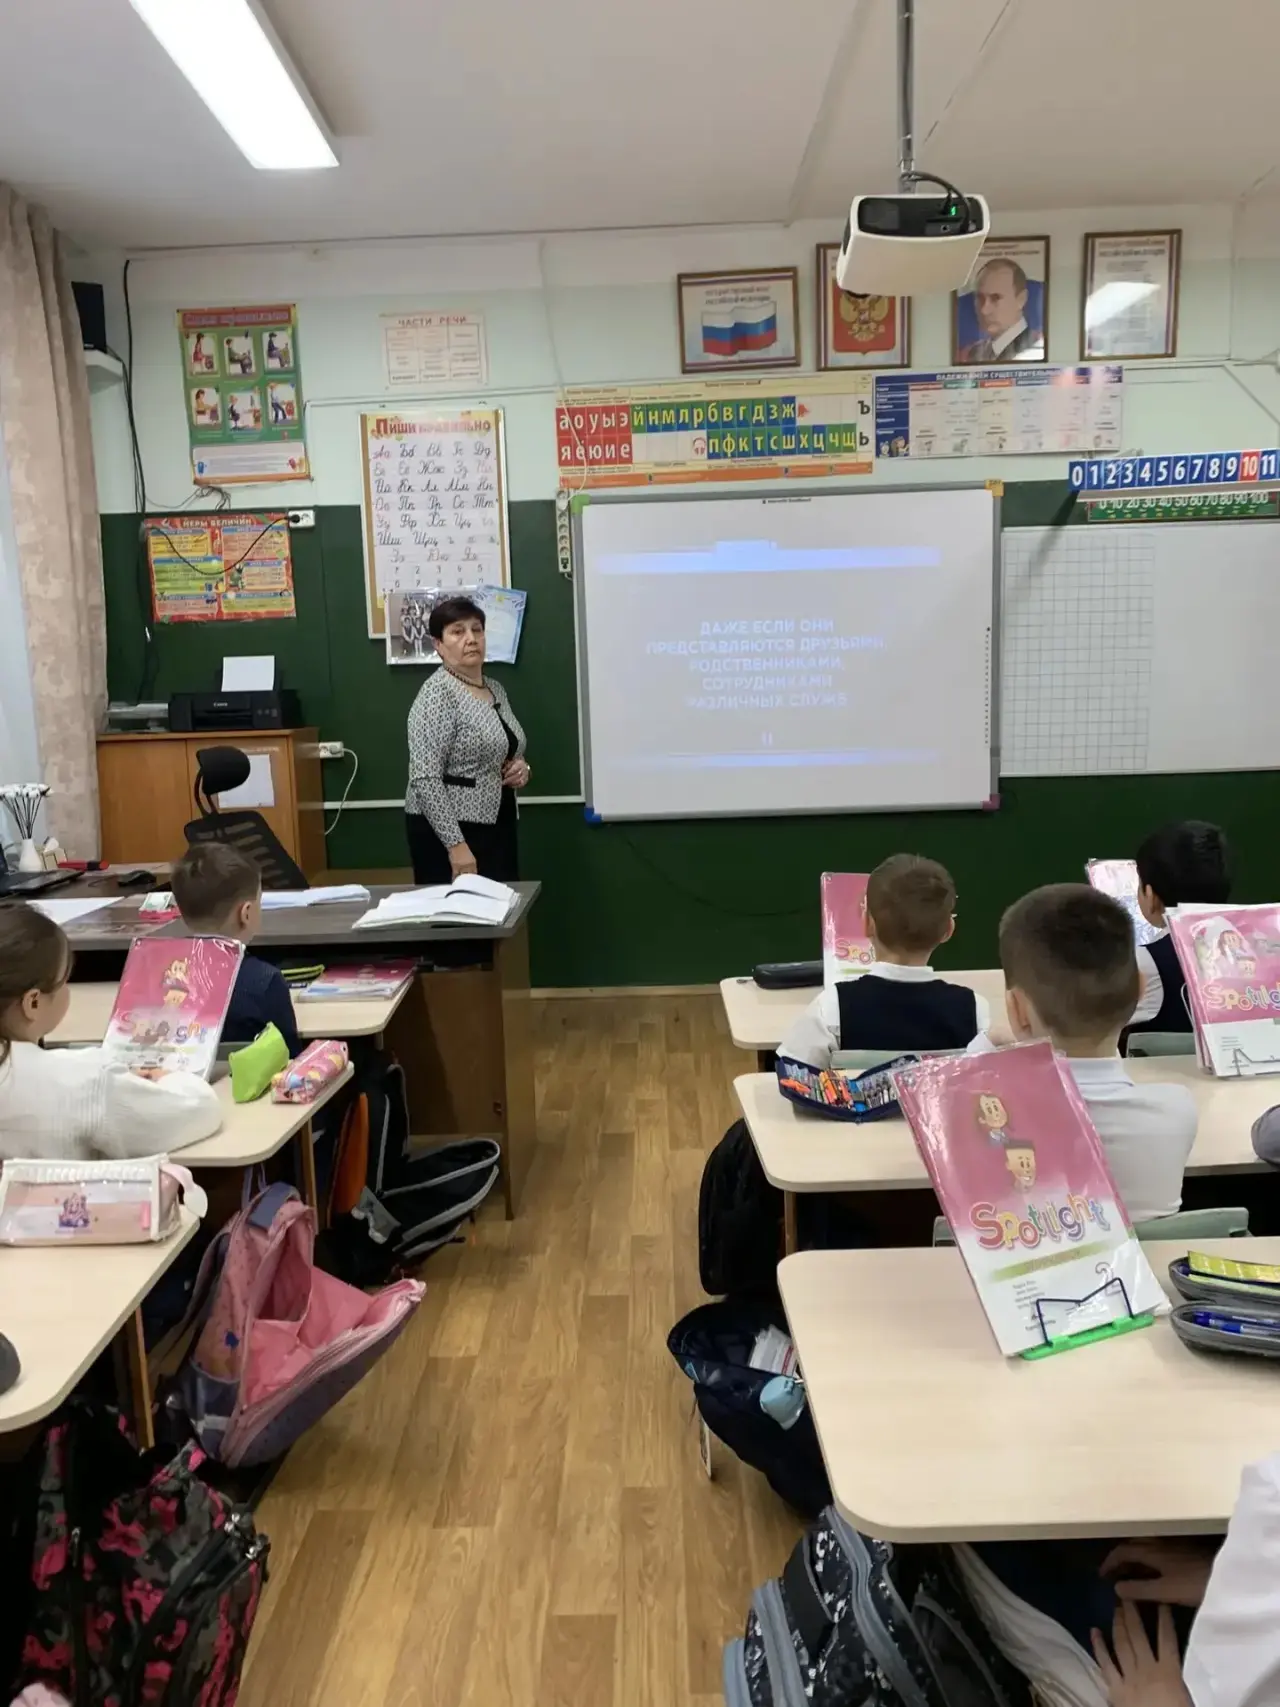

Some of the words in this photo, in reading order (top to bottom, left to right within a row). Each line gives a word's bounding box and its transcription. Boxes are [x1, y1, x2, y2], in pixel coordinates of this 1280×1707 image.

[398, 317, 432, 327] ЧАСТИ
[574, 415, 584, 428] о
[589, 413, 599, 433] у
[603, 413, 615, 428] ы
[620, 412, 629, 426] э
[648, 412, 659, 425] н
[662, 410, 675, 425] м
[679, 409, 689, 424] л
[693, 408, 704, 428] р
[708, 402, 718, 422] б
[723, 409, 734, 422] в
[739, 407, 747, 421] г
[752, 405, 765, 424] д
[769, 404, 778, 419] з
[782, 403, 795, 418] ж
[589, 445, 602, 460] ю
[605, 444, 616, 459] и
[620, 443, 631, 458] е
[709, 438, 719, 453] п
[722, 433, 736, 457] ф
[782, 435, 795, 449] ш
[813, 433, 825, 452] ц
[829, 432, 839, 447] ч
[842, 431, 856, 449] щ
[1071, 465, 1083, 487] 0
[1089, 465, 1098, 485] 1
[1106, 464, 1117, 484] 2
[1123, 463, 1134, 484] 3
[1140, 462, 1151, 482] 4
[1158, 460, 1169, 482] 5
[1174, 459, 1186, 481] 6
[1192, 459, 1203, 480] 7
[1208, 458, 1220, 479] 8
[1226, 456, 1238, 478] 9
[1243, 455, 1258, 477] 10
[1261, 454, 1275, 476] 11
[699, 620, 748, 636] ДАЖЕ
[753, 619, 795, 635] ЕСЛИ
[799, 618, 834, 633] ОНИ
[1202, 981, 1280, 1012] Spotlig
[968, 1192, 1111, 1250] Spotlight
